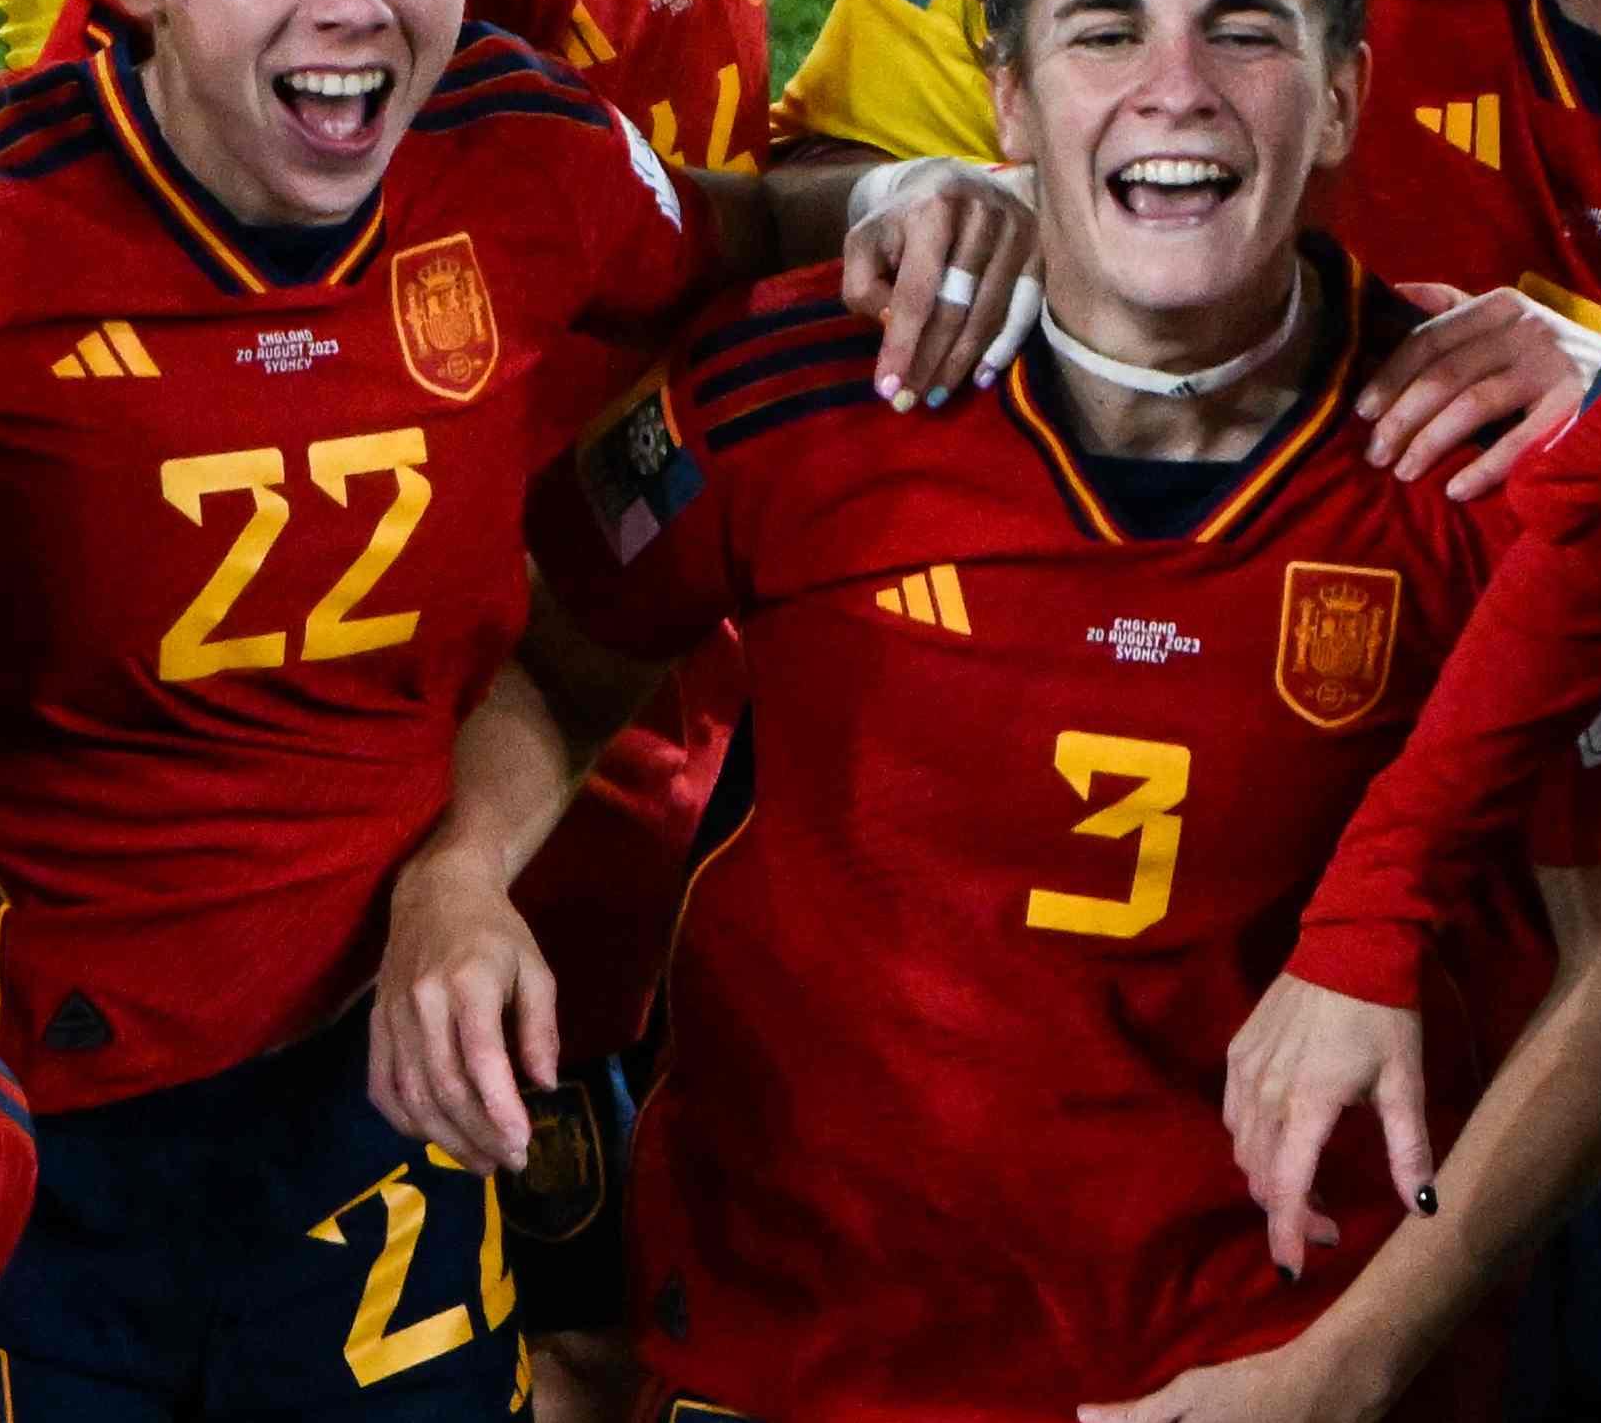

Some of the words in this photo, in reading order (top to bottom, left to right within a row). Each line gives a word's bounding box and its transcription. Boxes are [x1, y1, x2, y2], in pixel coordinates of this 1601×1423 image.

[258, 329, 314, 346] ENGLAND
[236, 349, 253, 363] 20
[257, 343, 303, 360] AUGUST
[309, 339, 339, 356] 2023
[264, 357, 313, 374] SYDNEY
[158, 427, 432, 683] 22
[1114, 617, 1177, 636] ENGLAND
[1086, 627, 1104, 642] 20
[1108, 629, 1161, 649] AUGUST
[1165, 635, 1201, 653] 2023
[1115, 644, 1169, 664] SYDNEY
[1025, 730, 1191, 939] 3
